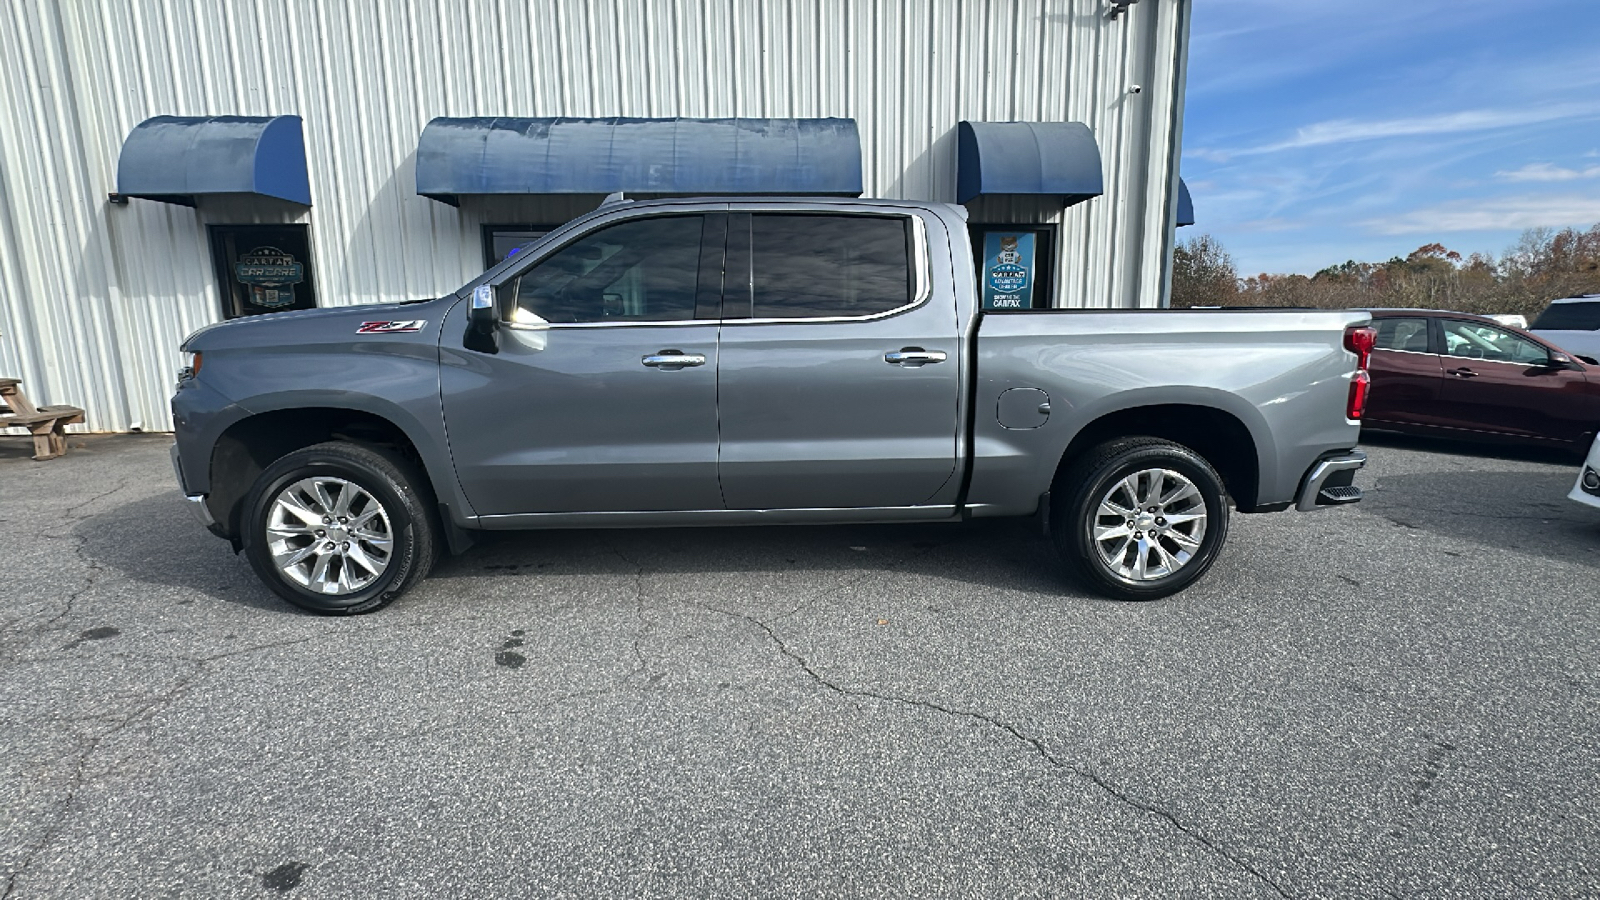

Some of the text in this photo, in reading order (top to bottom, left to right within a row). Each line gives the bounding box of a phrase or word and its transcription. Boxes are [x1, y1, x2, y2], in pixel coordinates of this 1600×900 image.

[244, 258, 292, 267] CARFAX
[241, 267, 296, 276] CAR CARE
[993, 299, 1021, 308] CARFAX
[356, 320, 428, 334] Z71
